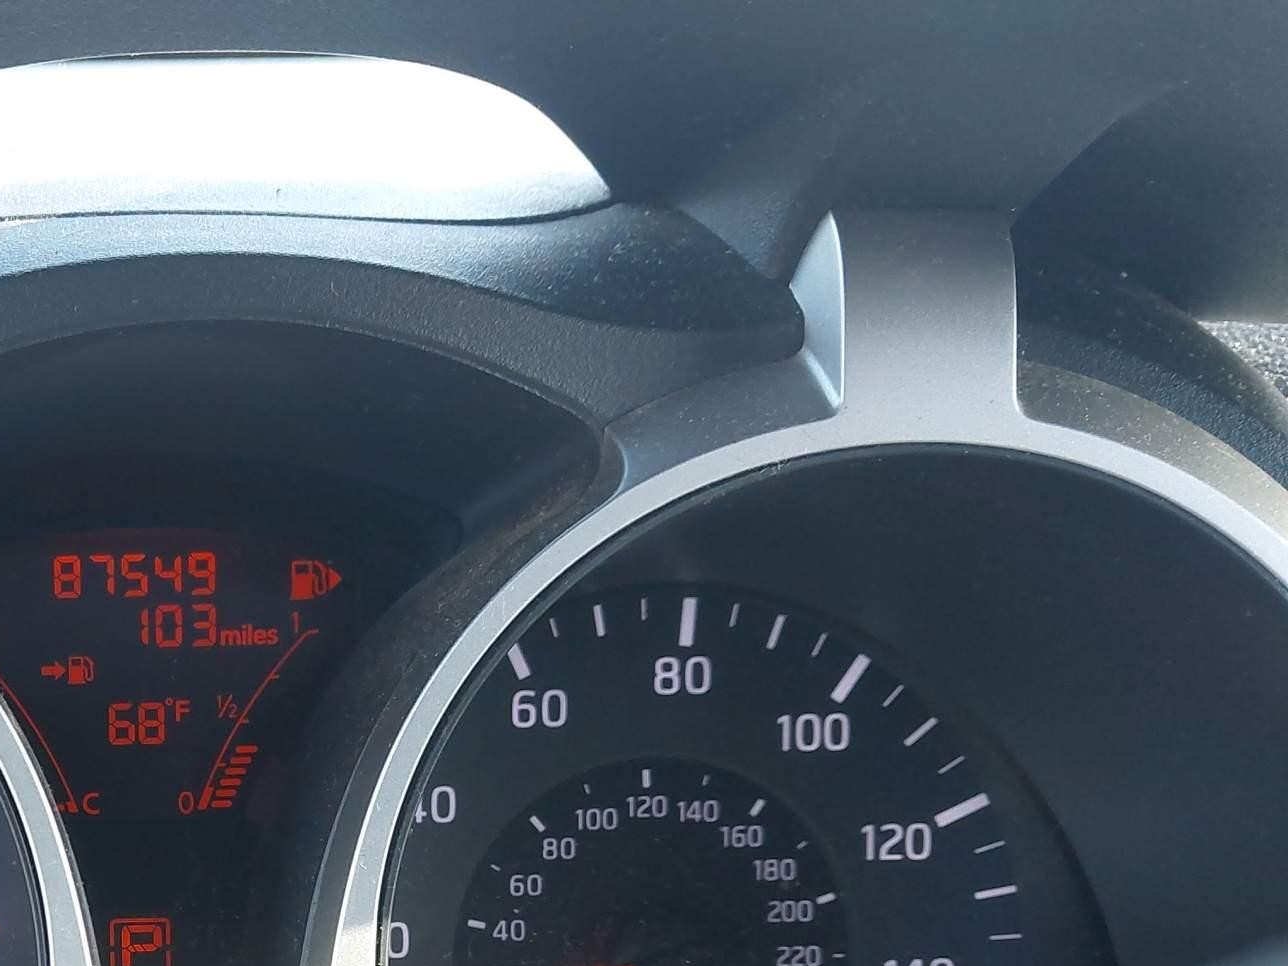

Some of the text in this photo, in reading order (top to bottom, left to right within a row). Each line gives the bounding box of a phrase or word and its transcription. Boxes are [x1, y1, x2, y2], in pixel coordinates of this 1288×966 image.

[54, 552, 215, 598] 87549
[141, 604, 279, 647] 103 miles
[655, 657, 710, 695] 80
[512, 690, 566, 728] 60
[778, 713, 849, 751] 100
[83, 793, 99, 814] C
[627, 796, 667, 817] 120
[678, 800, 718, 822] 140
[576, 808, 617, 830] 100
[722, 826, 762, 847] 160
[862, 820, 931, 860] 120
[543, 838, 575, 859] 80
[755, 859, 794, 880] 180
[510, 875, 541, 896] 60
[768, 901, 812, 922] 200
[493, 920, 524, 941] 40
[778, 946, 820, 966] 220
